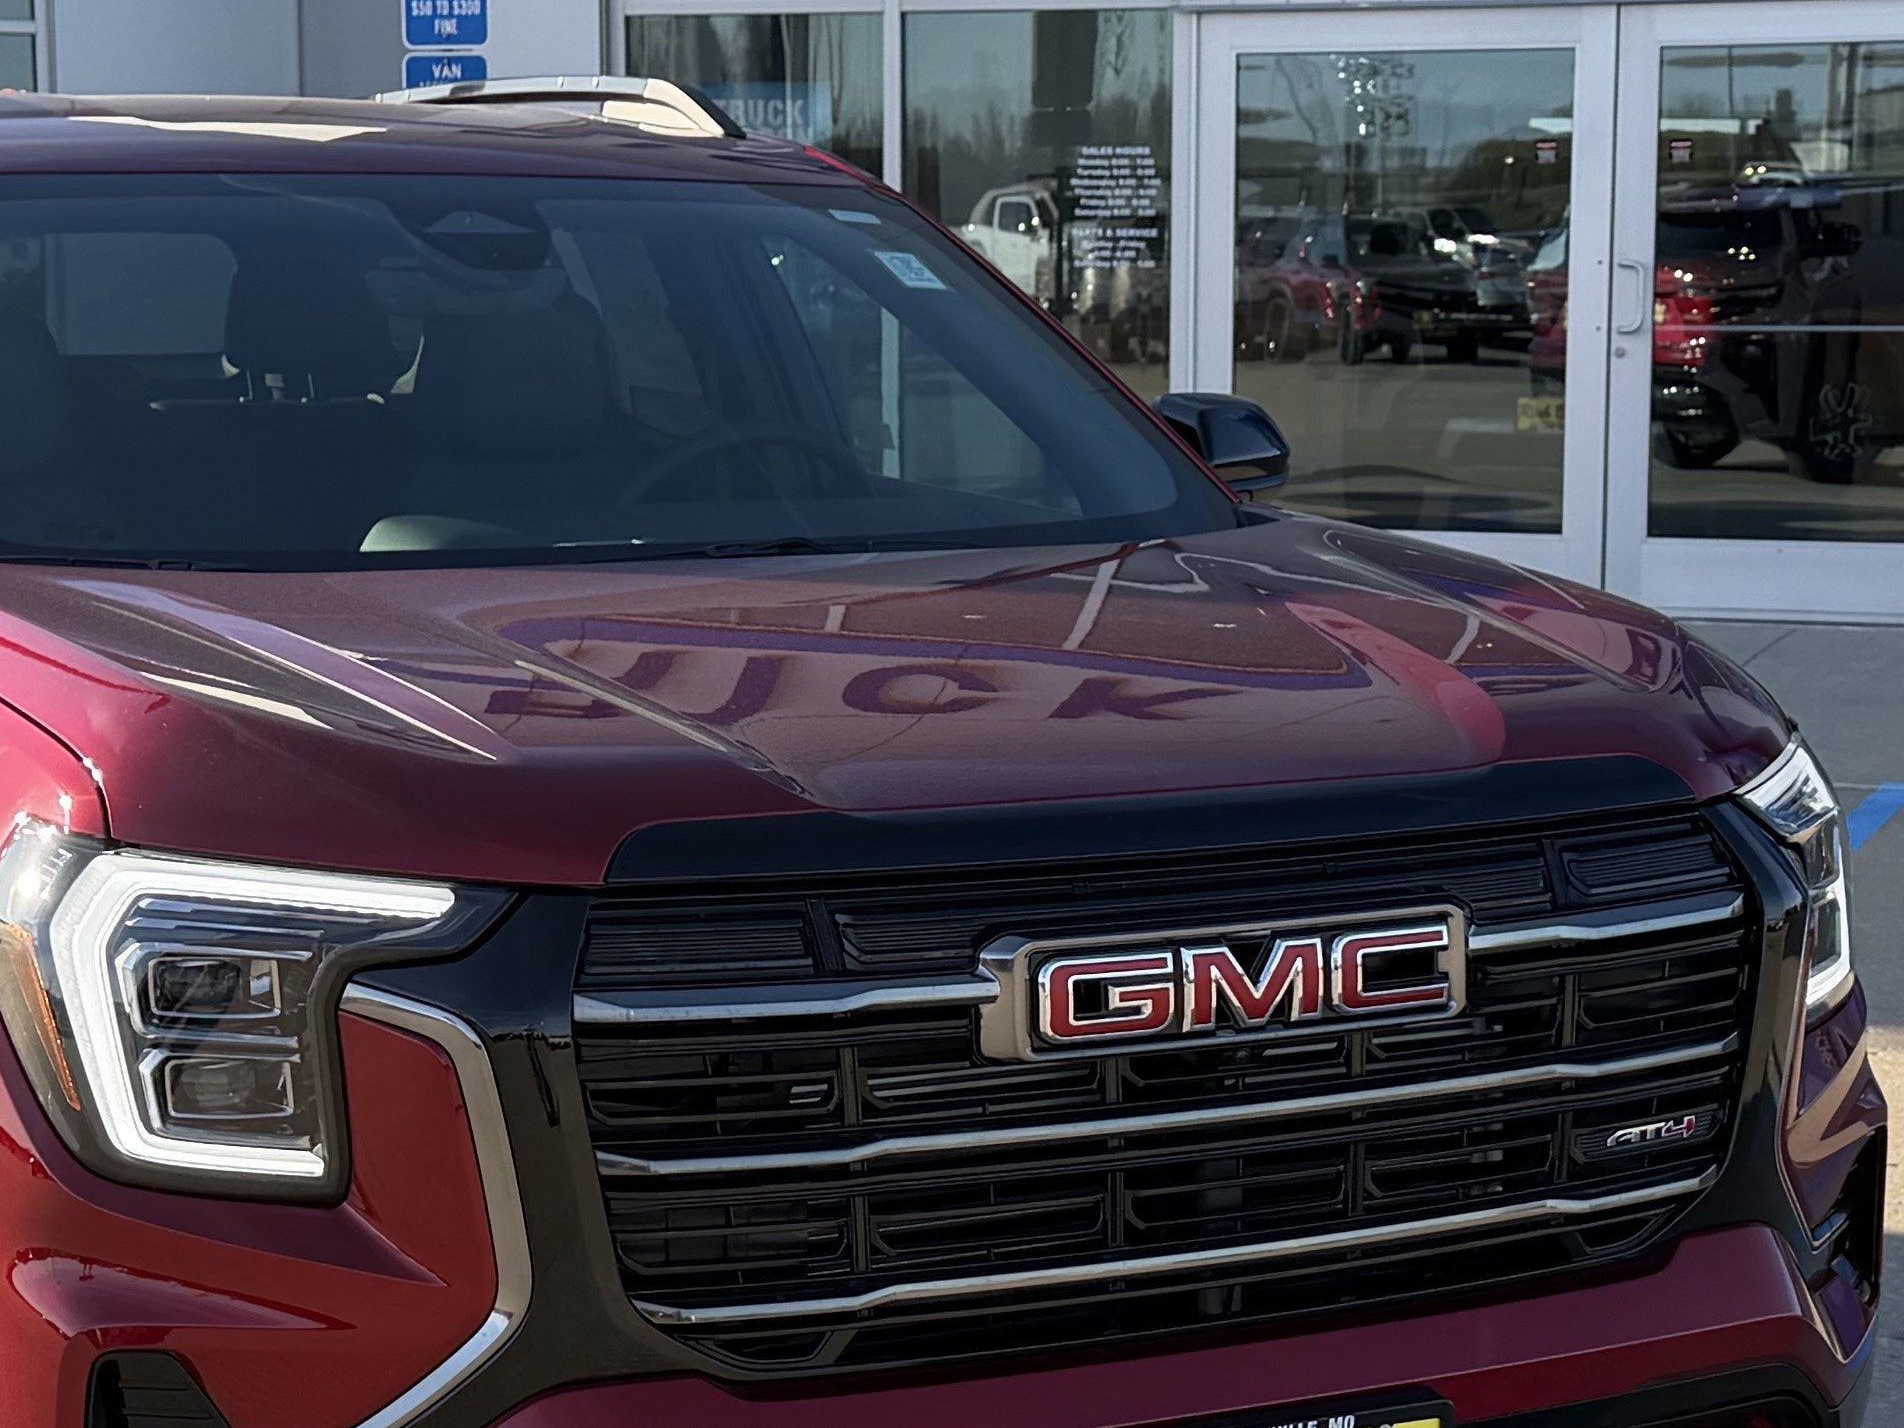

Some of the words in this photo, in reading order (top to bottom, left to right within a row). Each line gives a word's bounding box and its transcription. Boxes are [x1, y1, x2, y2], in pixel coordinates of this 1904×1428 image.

[436, 0, 450, 16] TO
[434, 18, 458, 35] FINE
[431, 62, 463, 79] VAN
[1037, 924, 1451, 1044] GMC
[1606, 1115, 1696, 1147] AT4
